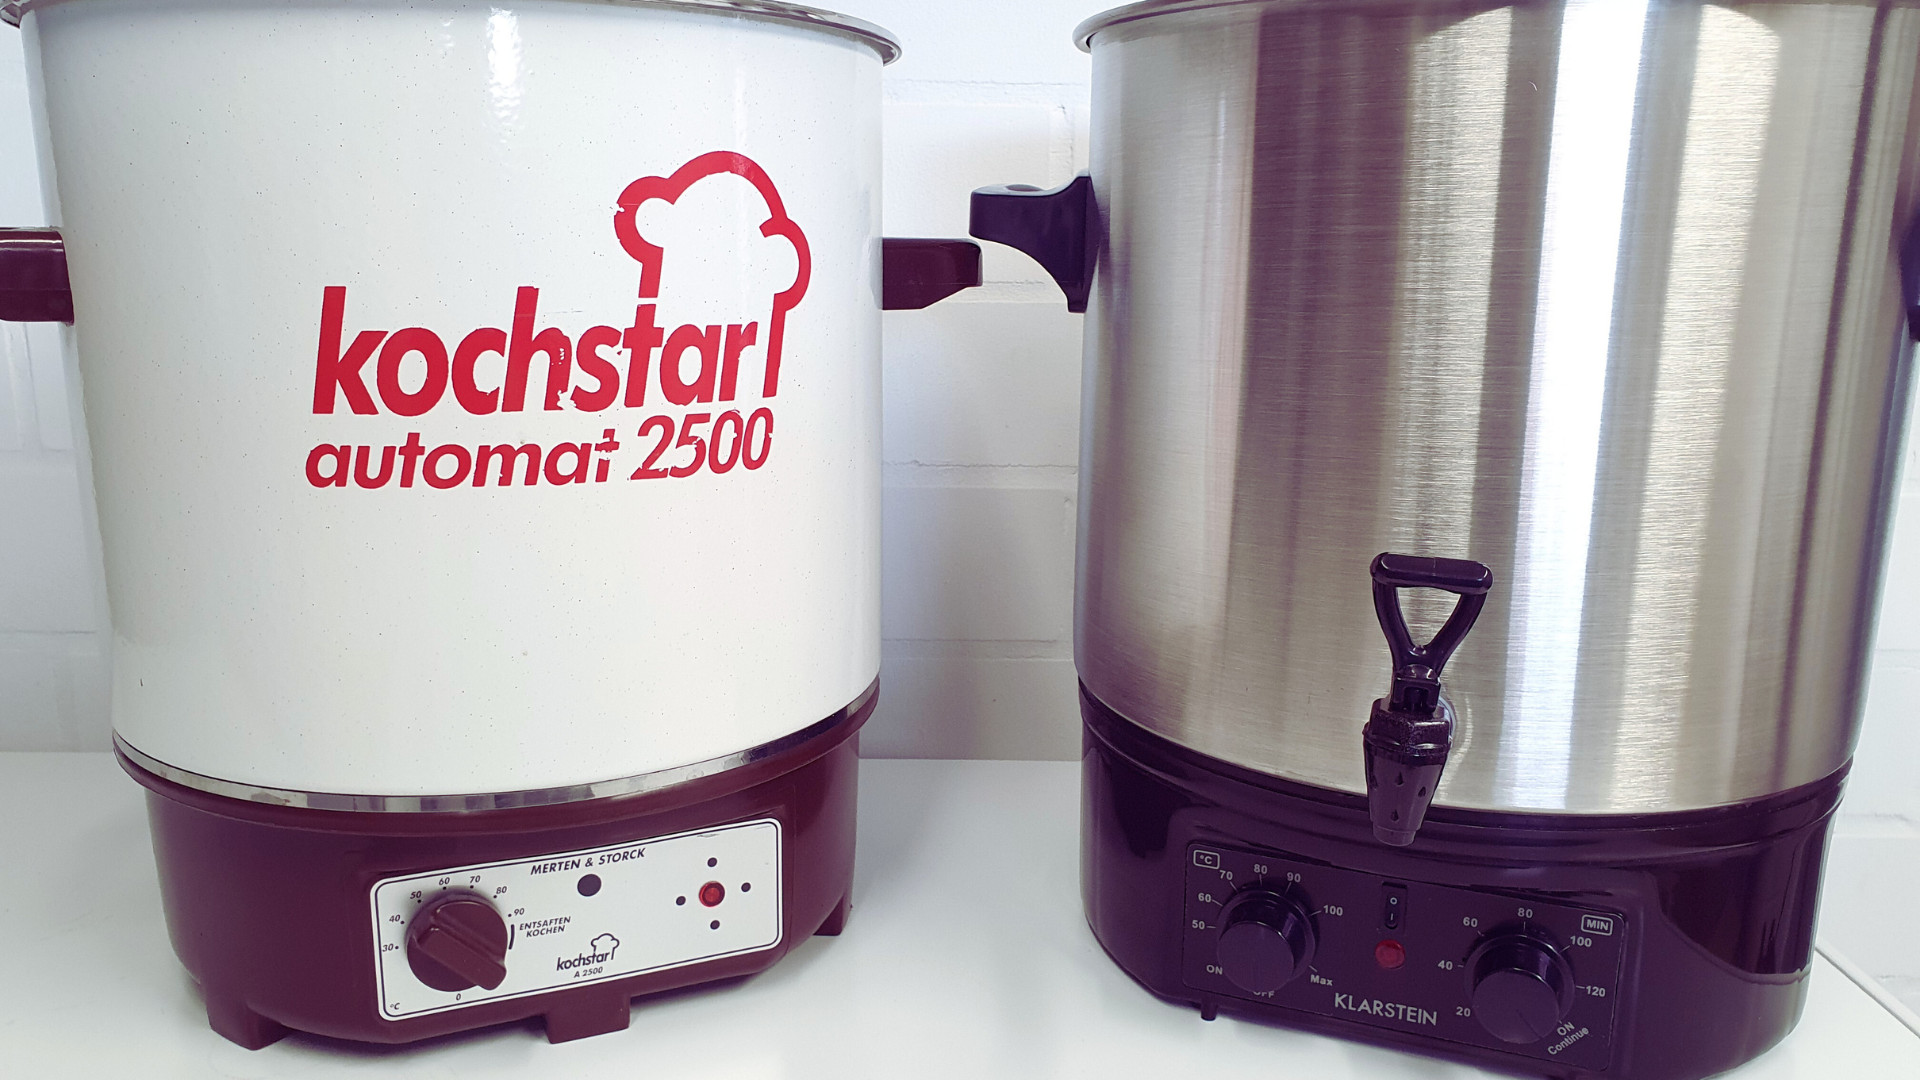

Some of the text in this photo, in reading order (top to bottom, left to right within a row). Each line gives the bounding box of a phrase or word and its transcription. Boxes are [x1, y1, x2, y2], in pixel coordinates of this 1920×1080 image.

[312, 285, 758, 416] kochstar
[305, 408, 774, 489] automat 2500
[530, 848, 646, 875] MERTEN & STORCK
[1253, 864, 1268, 874] 80
[469, 875, 481, 884] 70
[1219, 870, 1233, 880] 70
[1286, 872, 1301, 883] 90
[438, 877, 450, 885] 60
[410, 890, 422, 899] 50
[496, 886, 507, 894] 80
[1198, 893, 1212, 903] 60
[514, 908, 525, 916] 90
[1323, 905, 1343, 917] 100
[1517, 908, 1533, 919] 80
[389, 914, 401, 922] 40
[519, 916, 571, 930] ENTSAFTEN
[1462, 917, 1478, 928] 60
[1191, 920, 1205, 930] 50
[1586, 919, 1609, 931] MIN
[526, 925, 565, 937] KOCHEN
[1570, 935, 1592, 947] 100
[382, 943, 393, 952] 30
[556, 952, 611, 971] kochstar
[1437, 960, 1453, 971] 40
[573, 966, 603, 978] A 2500
[1206, 964, 1223, 975] ON
[1310, 974, 1333, 987] Max
[1585, 985, 1606, 997] 120
[1334, 993, 1437, 1027] KLARSTEIN
[1456, 1006, 1471, 1017] 20
[1557, 1022, 1575, 1037] ON
[1548, 1026, 1590, 1055] Continue
